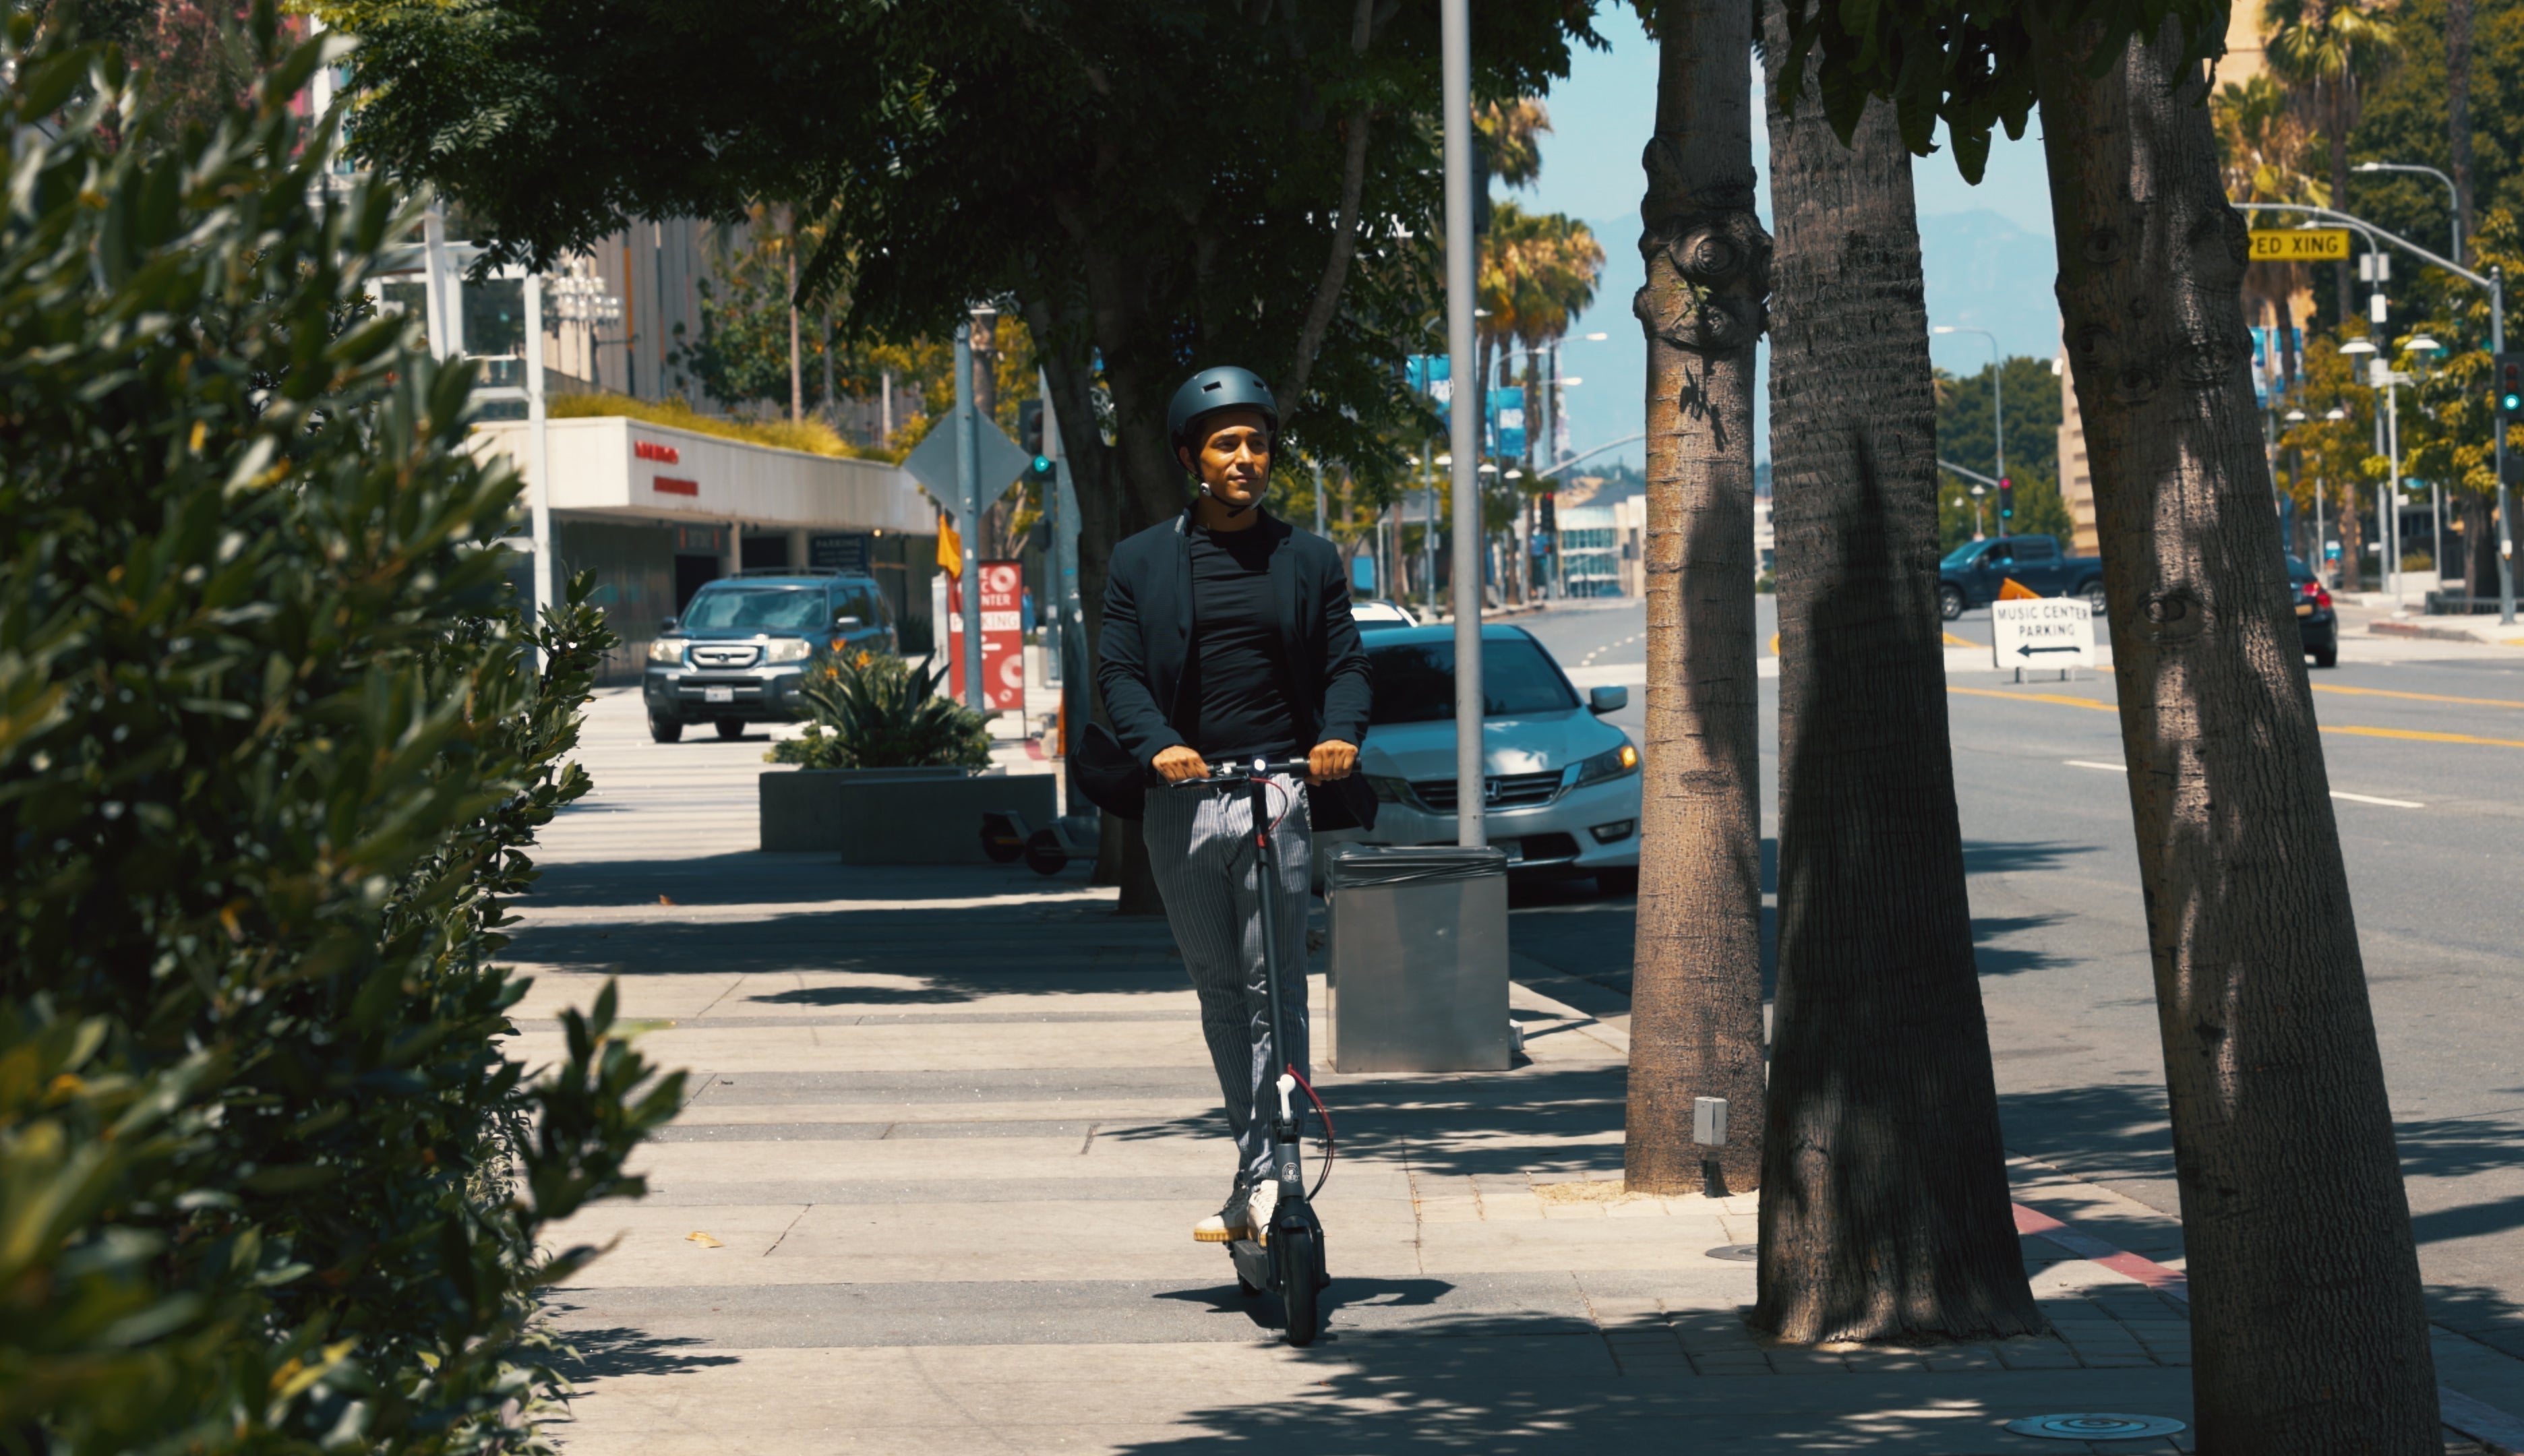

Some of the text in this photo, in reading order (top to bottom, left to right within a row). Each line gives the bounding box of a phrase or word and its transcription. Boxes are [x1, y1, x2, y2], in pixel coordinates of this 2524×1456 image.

[2293, 236, 2339, 253] XING
[981, 594, 1011, 606] NTER
[953, 613, 1018, 629] PKING
[1997, 605, 2089, 621] MUSIC CENTER
[2018, 624, 2075, 637] PARKING
